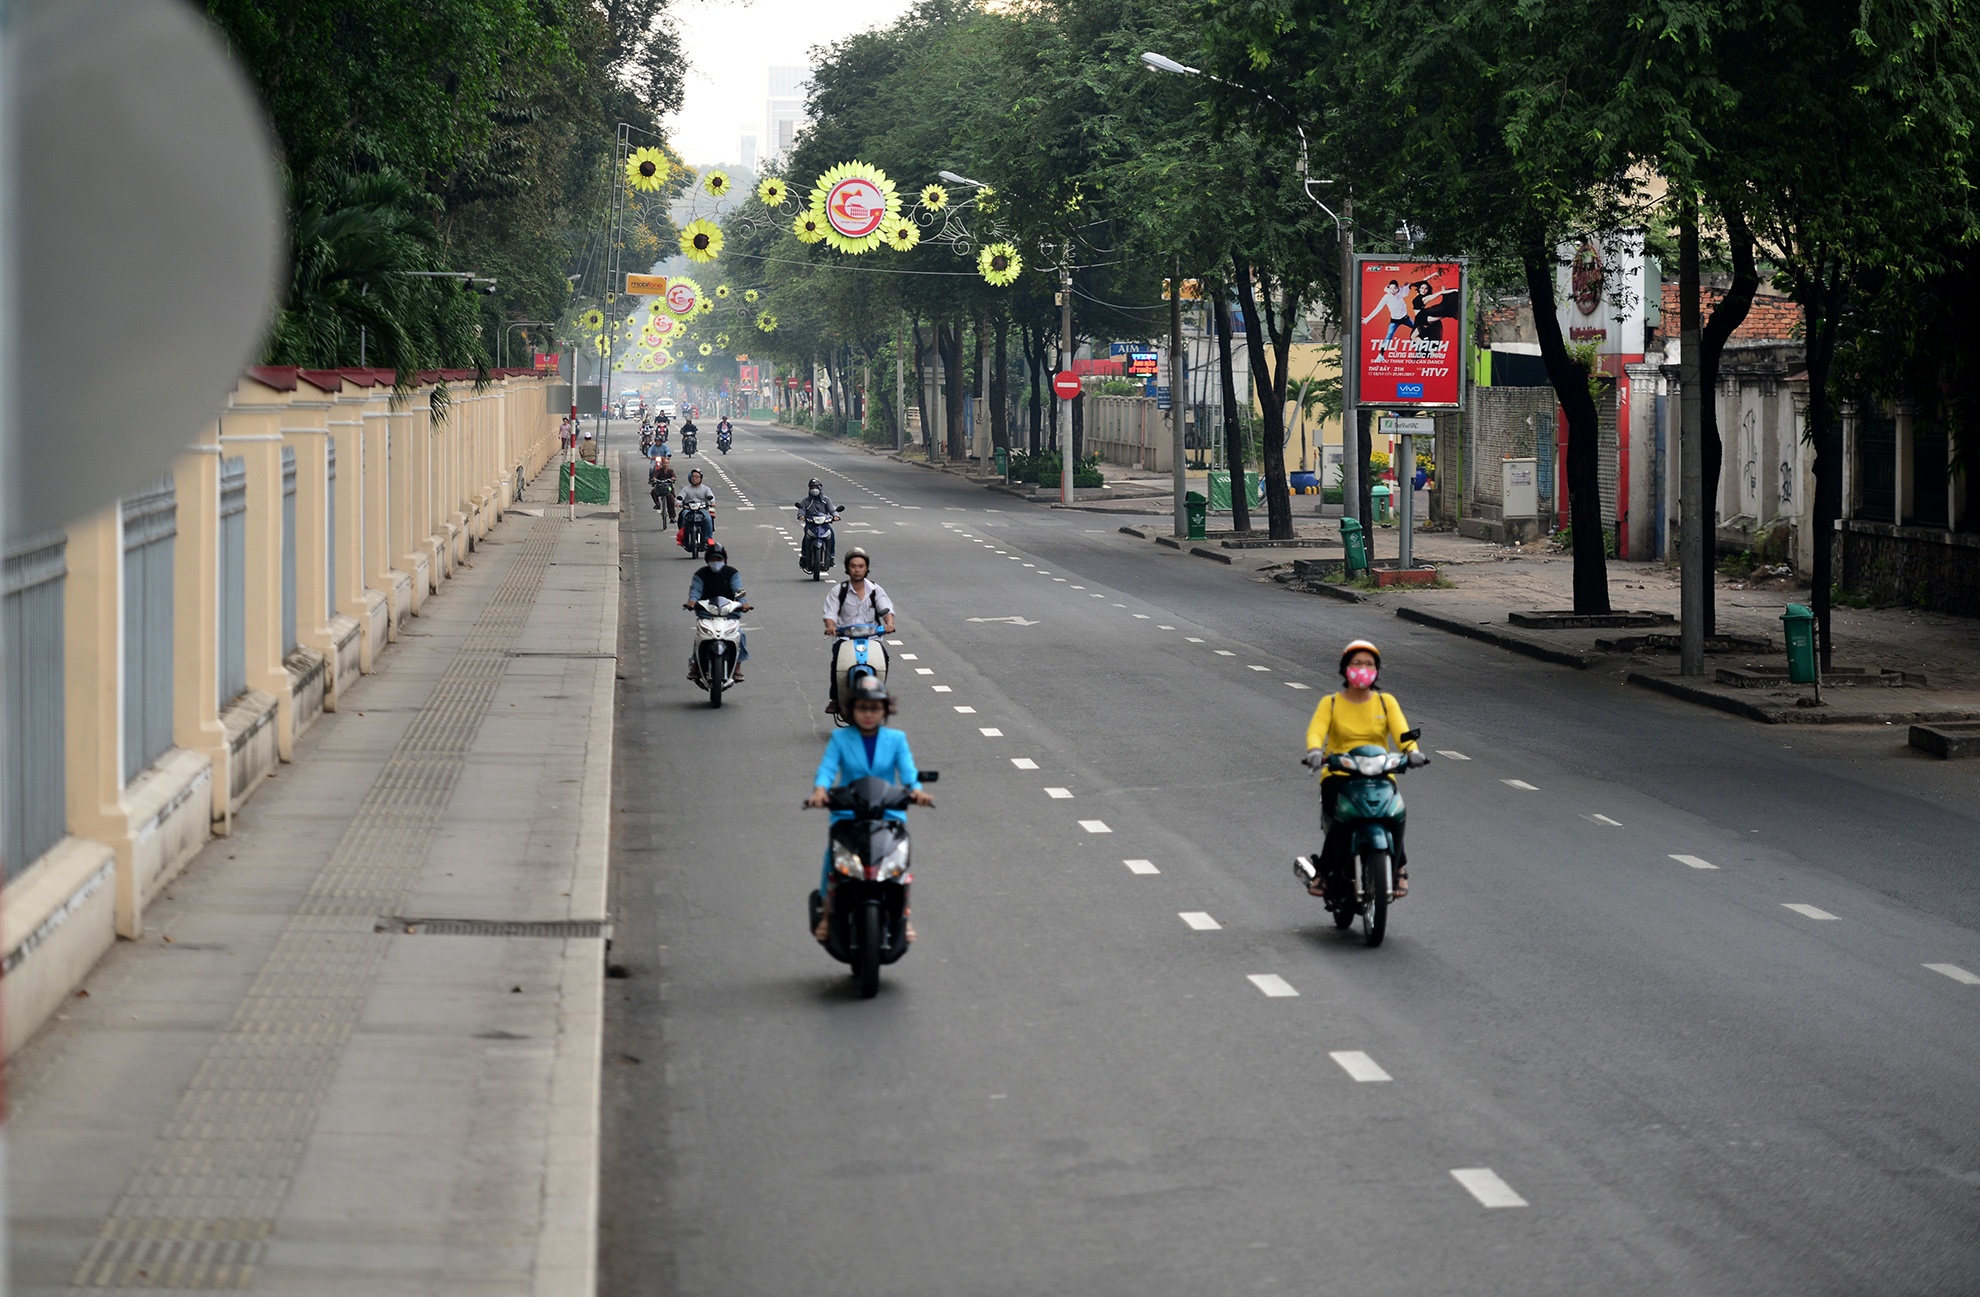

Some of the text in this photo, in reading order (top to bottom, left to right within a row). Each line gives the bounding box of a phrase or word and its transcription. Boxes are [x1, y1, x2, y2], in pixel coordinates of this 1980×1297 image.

[1118, 345, 1139, 353] AIM
[1402, 337, 1449, 352] THÁCH
[1421, 367, 1449, 377] HTV7
